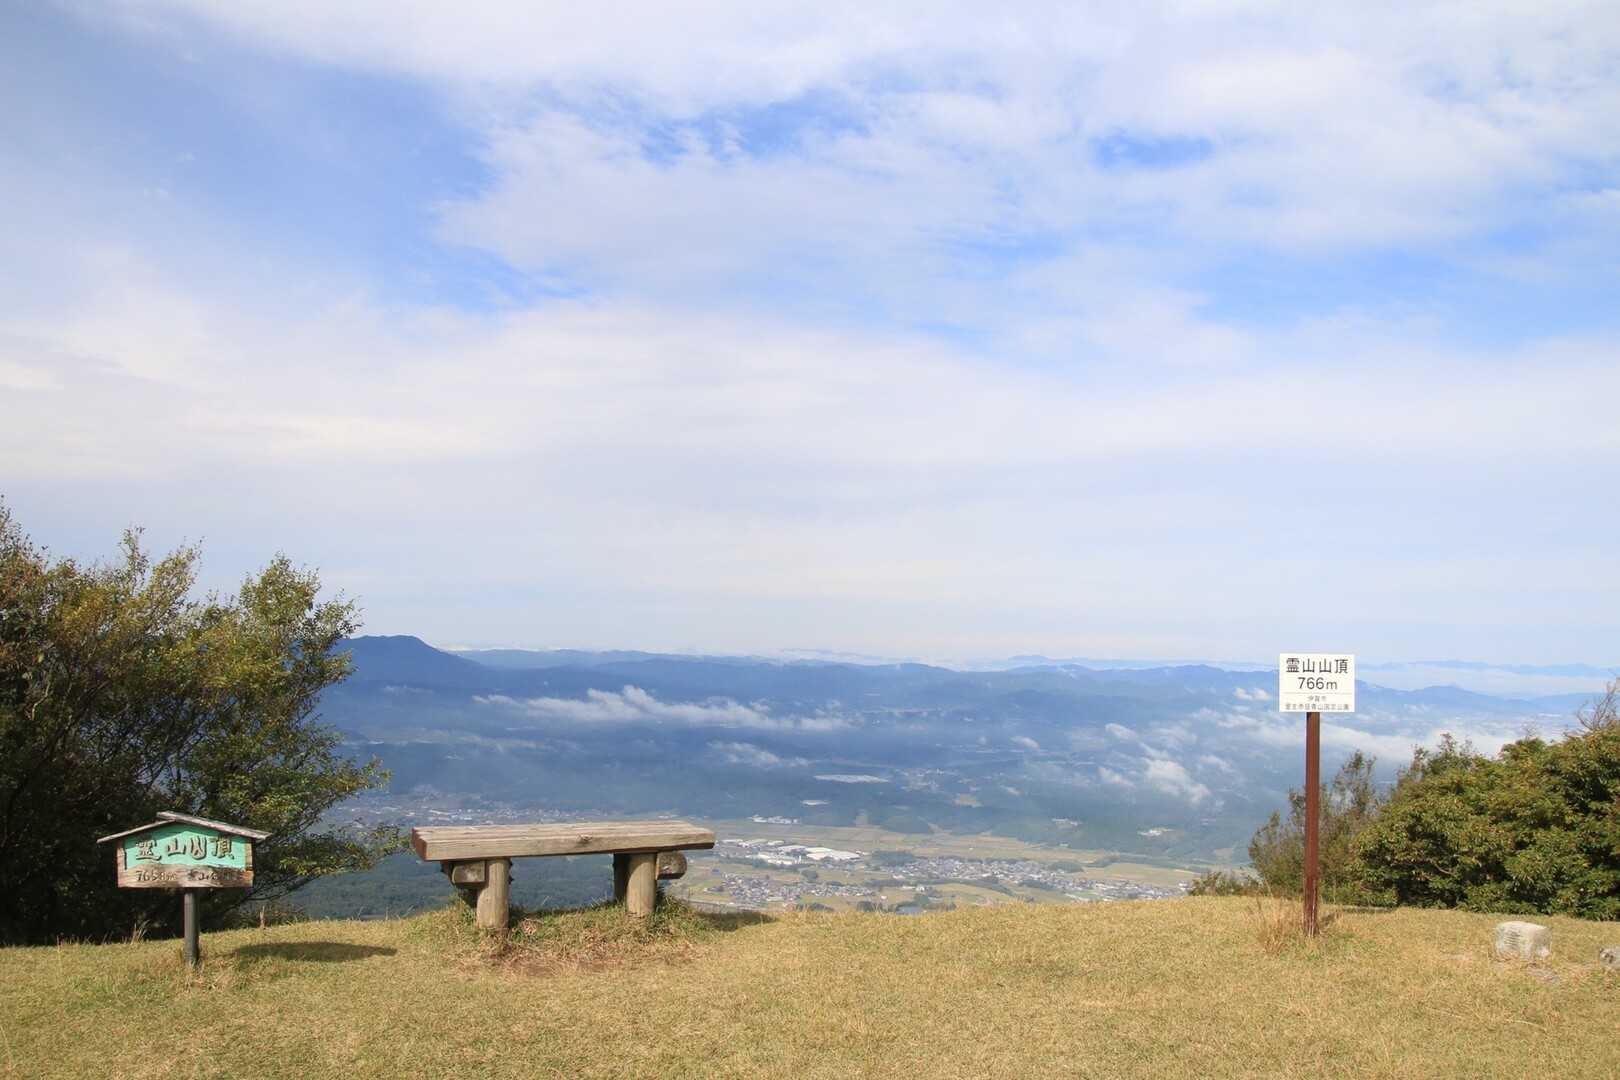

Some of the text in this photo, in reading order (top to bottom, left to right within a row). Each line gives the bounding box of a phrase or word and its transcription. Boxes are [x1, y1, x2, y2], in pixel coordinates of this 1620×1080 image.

[1286, 657, 1348, 674] 霊山山頂
[1297, 677, 1338, 690] 766m
